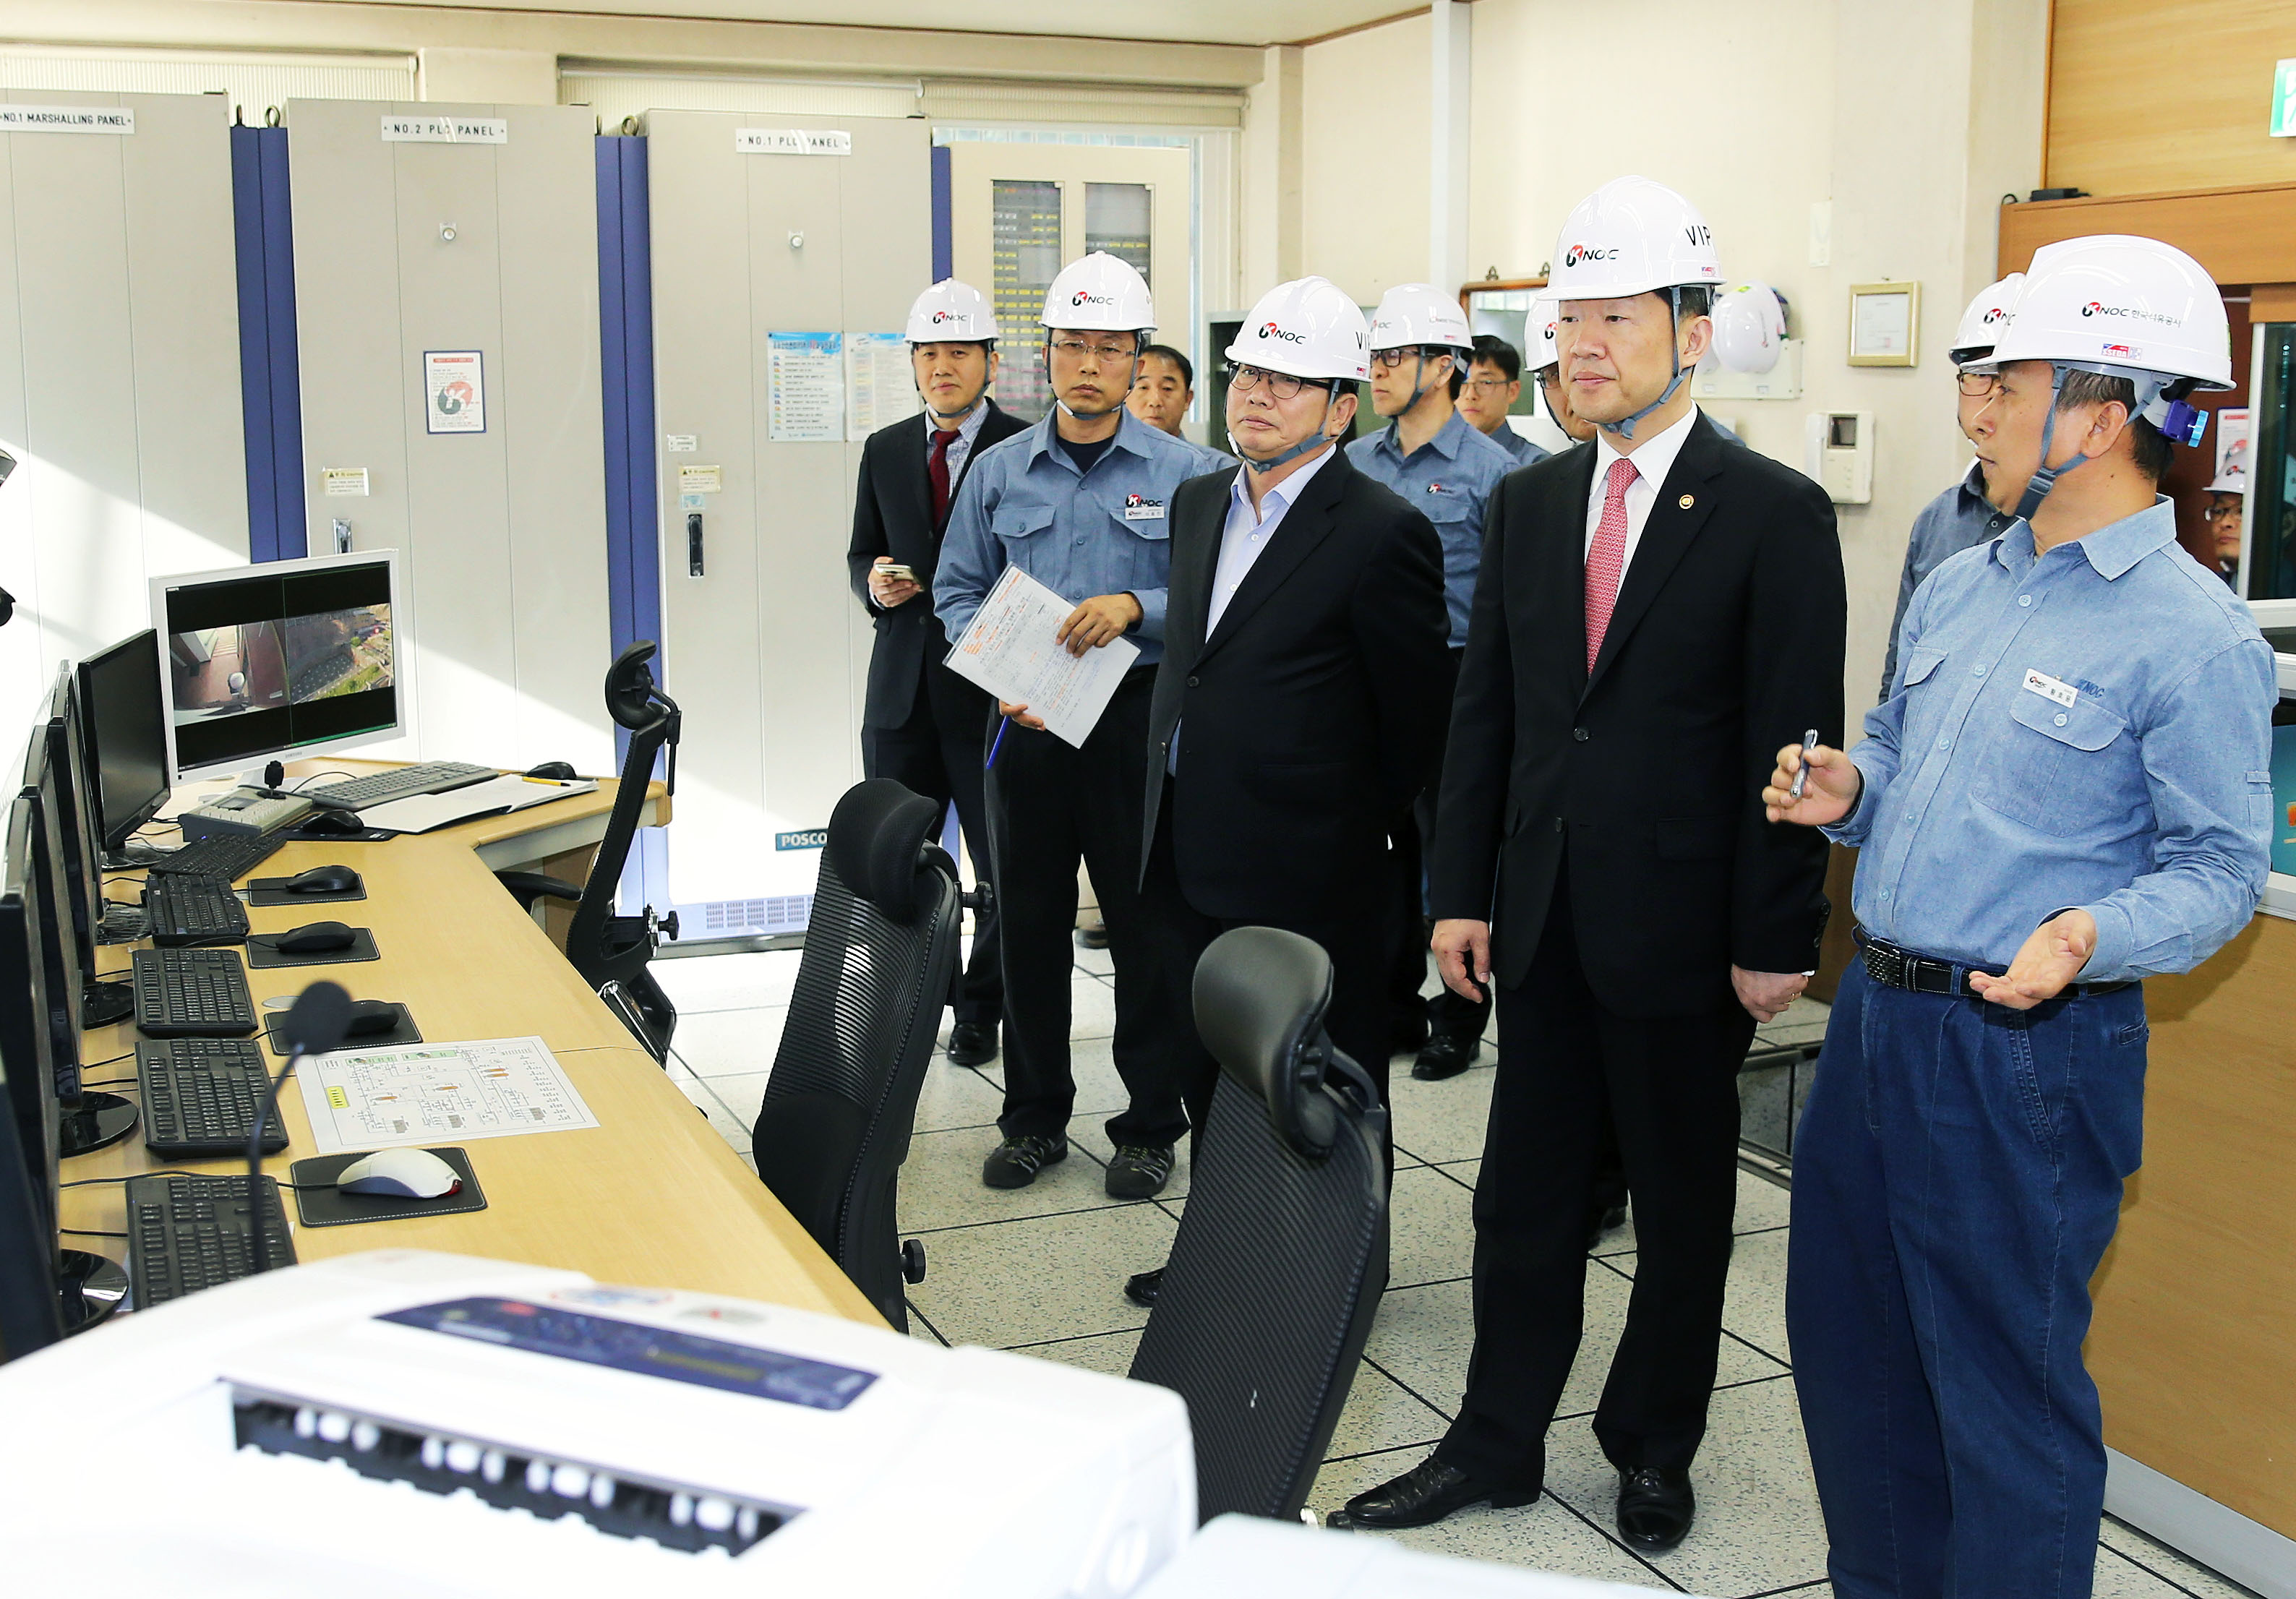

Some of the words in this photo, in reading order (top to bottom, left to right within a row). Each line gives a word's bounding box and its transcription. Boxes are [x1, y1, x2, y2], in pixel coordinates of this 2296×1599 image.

[4, 112, 22, 124] NO.1
[27, 113, 93, 125] MARSHALLING
[98, 114, 127, 126] PANEL
[394, 124, 421, 134] NO.2
[458, 125, 494, 136] PANEL
[748, 136, 771, 146] NO.1
[806, 137, 839, 148] ANEL
[1685, 225, 1710, 247] VIP
[1566, 244, 1619, 267] KNOC
[1072, 291, 1114, 306] KNOC
[2082, 301, 2130, 317] KNOC
[933, 312, 967, 324] KNOC
[1259, 322, 1306, 345] KNOC
[1126, 494, 1163, 507] KNOC
[781, 831, 828, 847] POSCO
